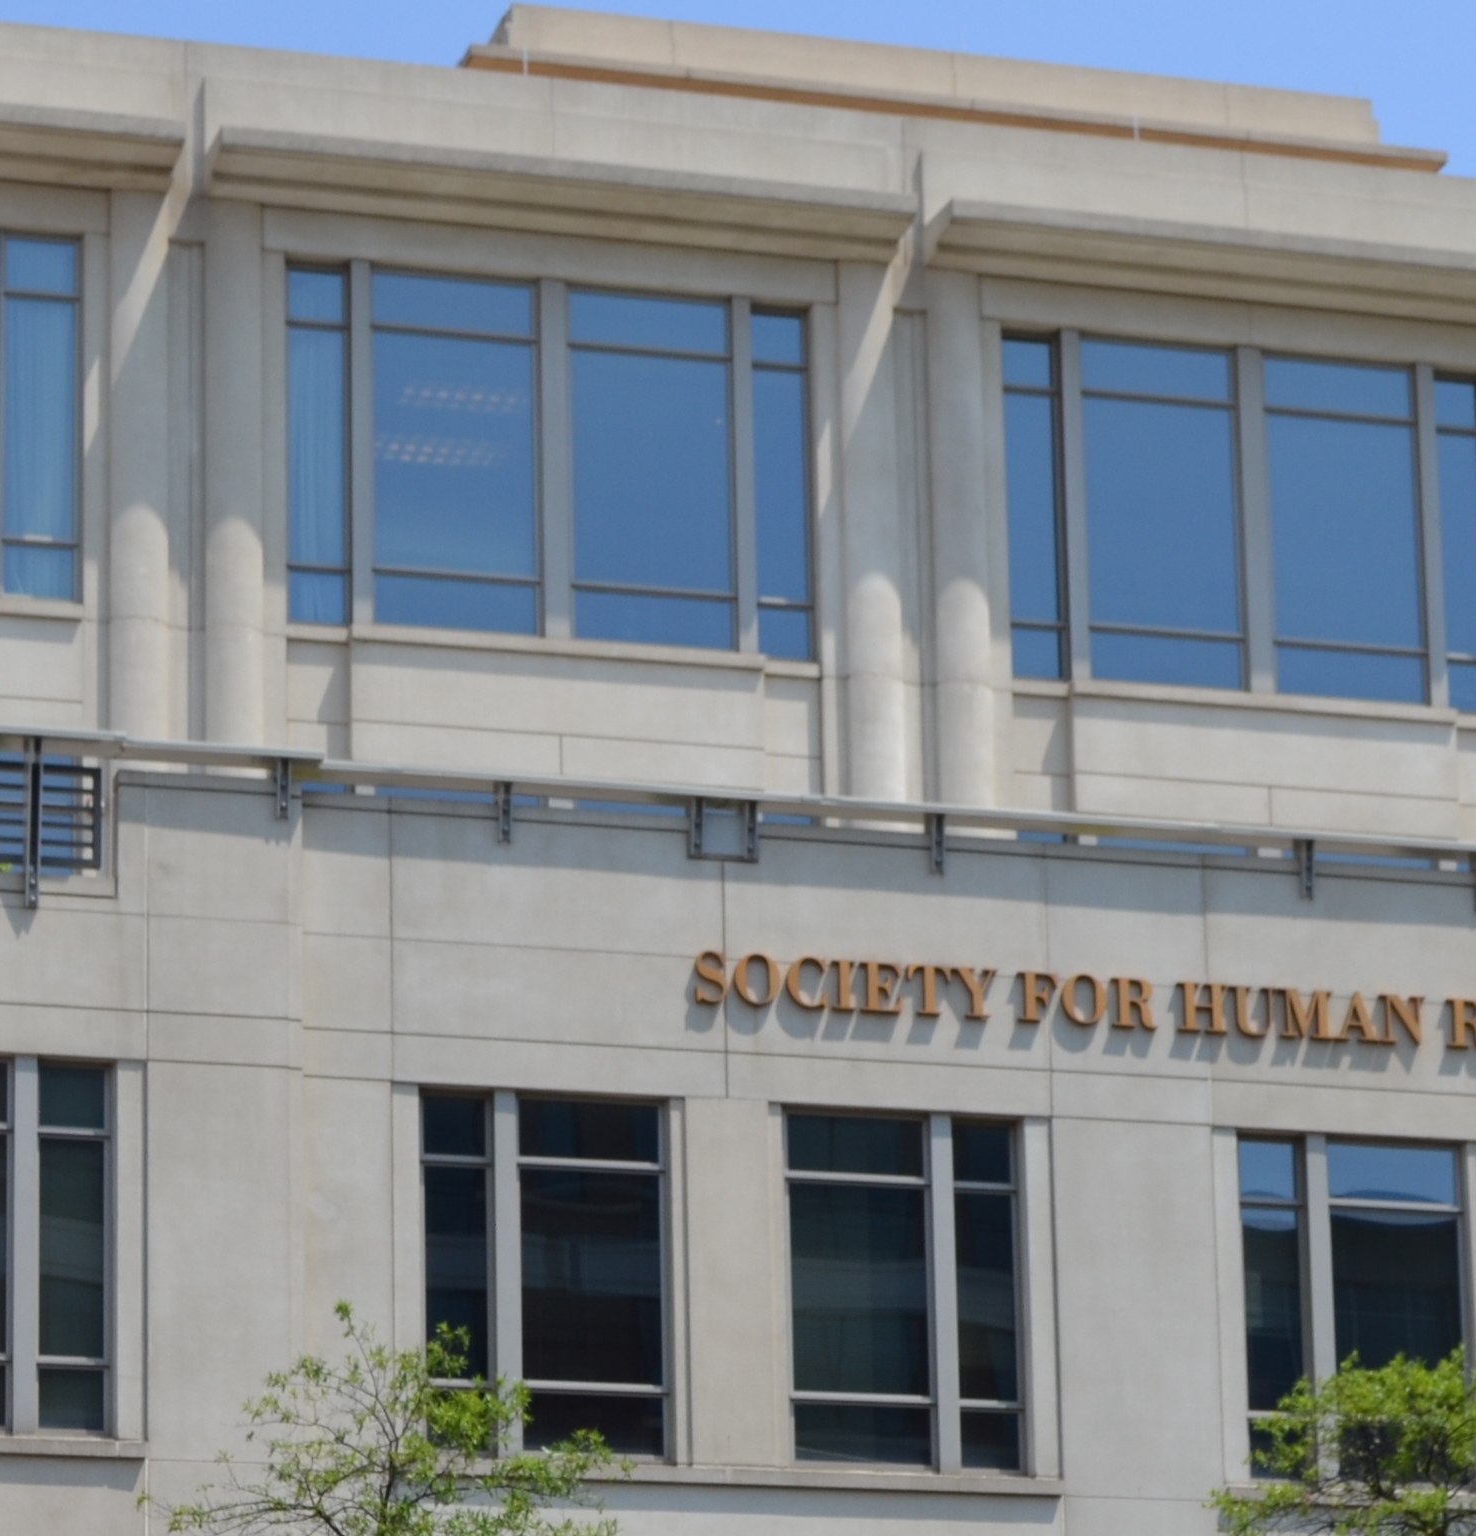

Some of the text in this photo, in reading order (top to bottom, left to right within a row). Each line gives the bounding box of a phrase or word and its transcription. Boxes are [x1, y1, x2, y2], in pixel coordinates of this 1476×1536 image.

[694, 950, 997, 1021] SOCIETY
[1016, 970, 1158, 1032] FOR
[1175, 981, 1425, 1047] HUMAN
